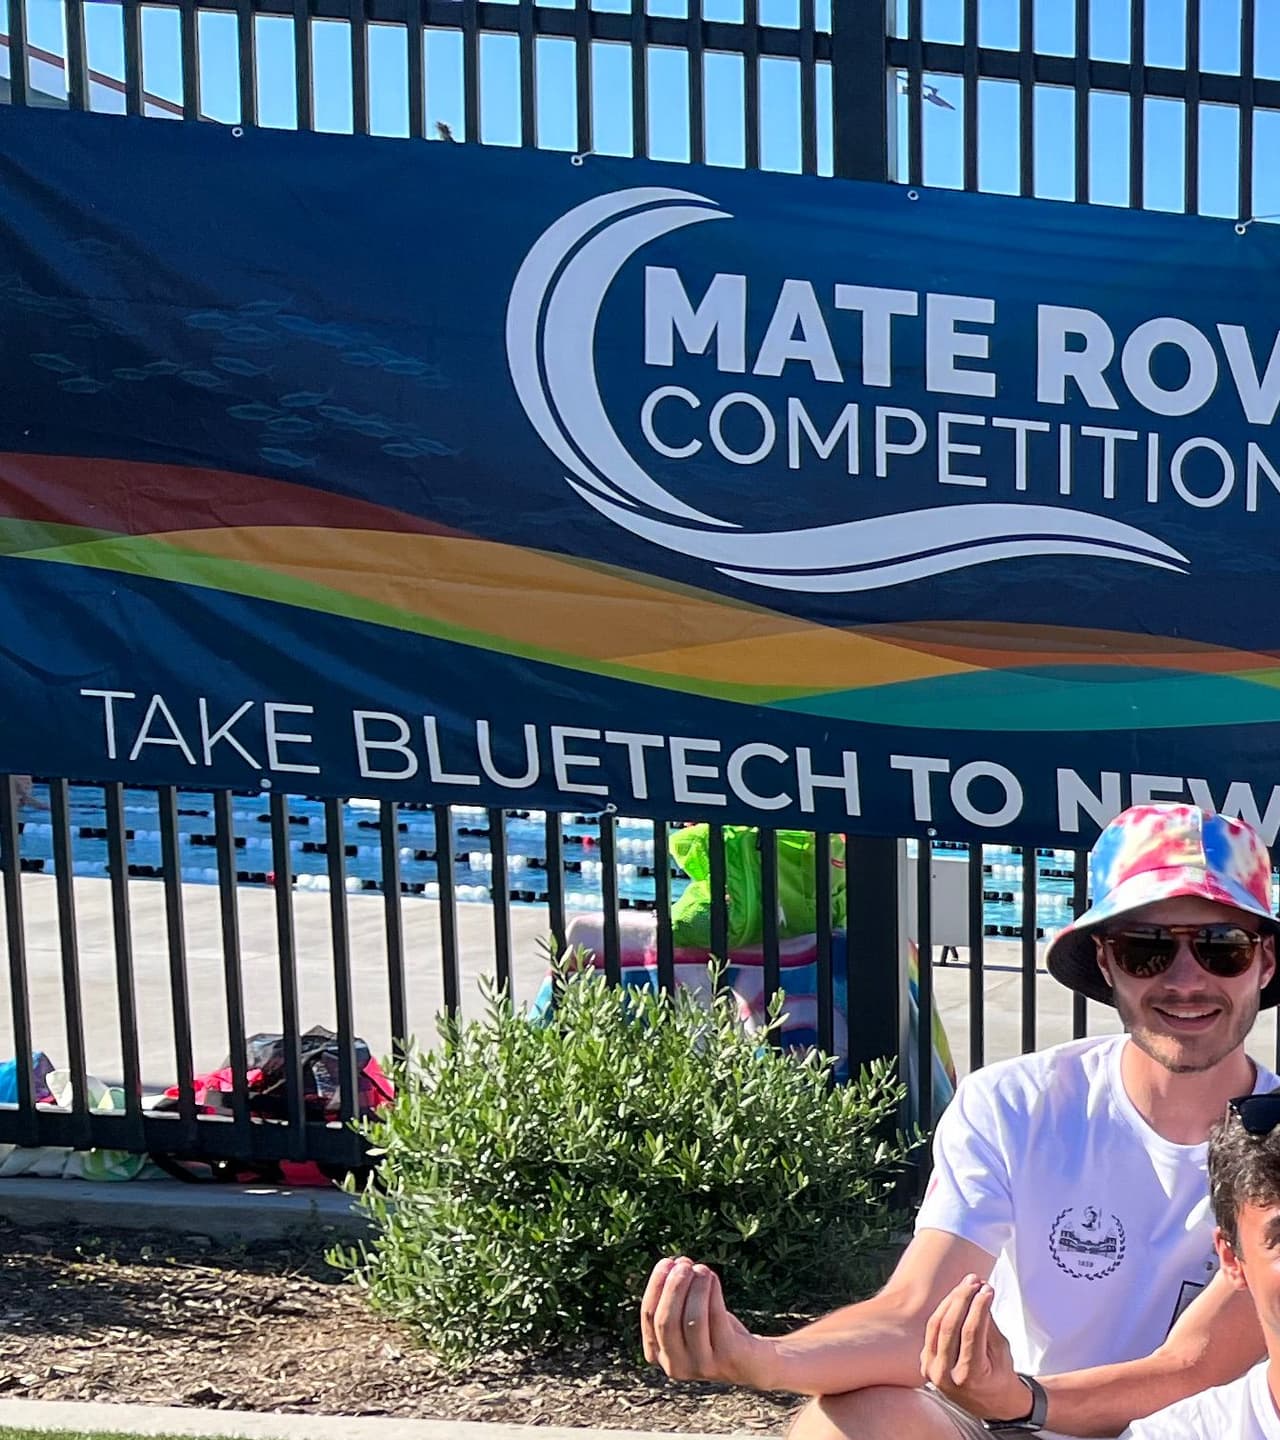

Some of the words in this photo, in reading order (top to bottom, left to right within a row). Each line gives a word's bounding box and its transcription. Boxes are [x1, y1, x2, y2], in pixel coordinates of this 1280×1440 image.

[644, 266, 997, 399] MATE
[80, 688, 321, 774] TAKE
[353, 710, 862, 817] BLUETECH
[890, 755, 1024, 828] TO
